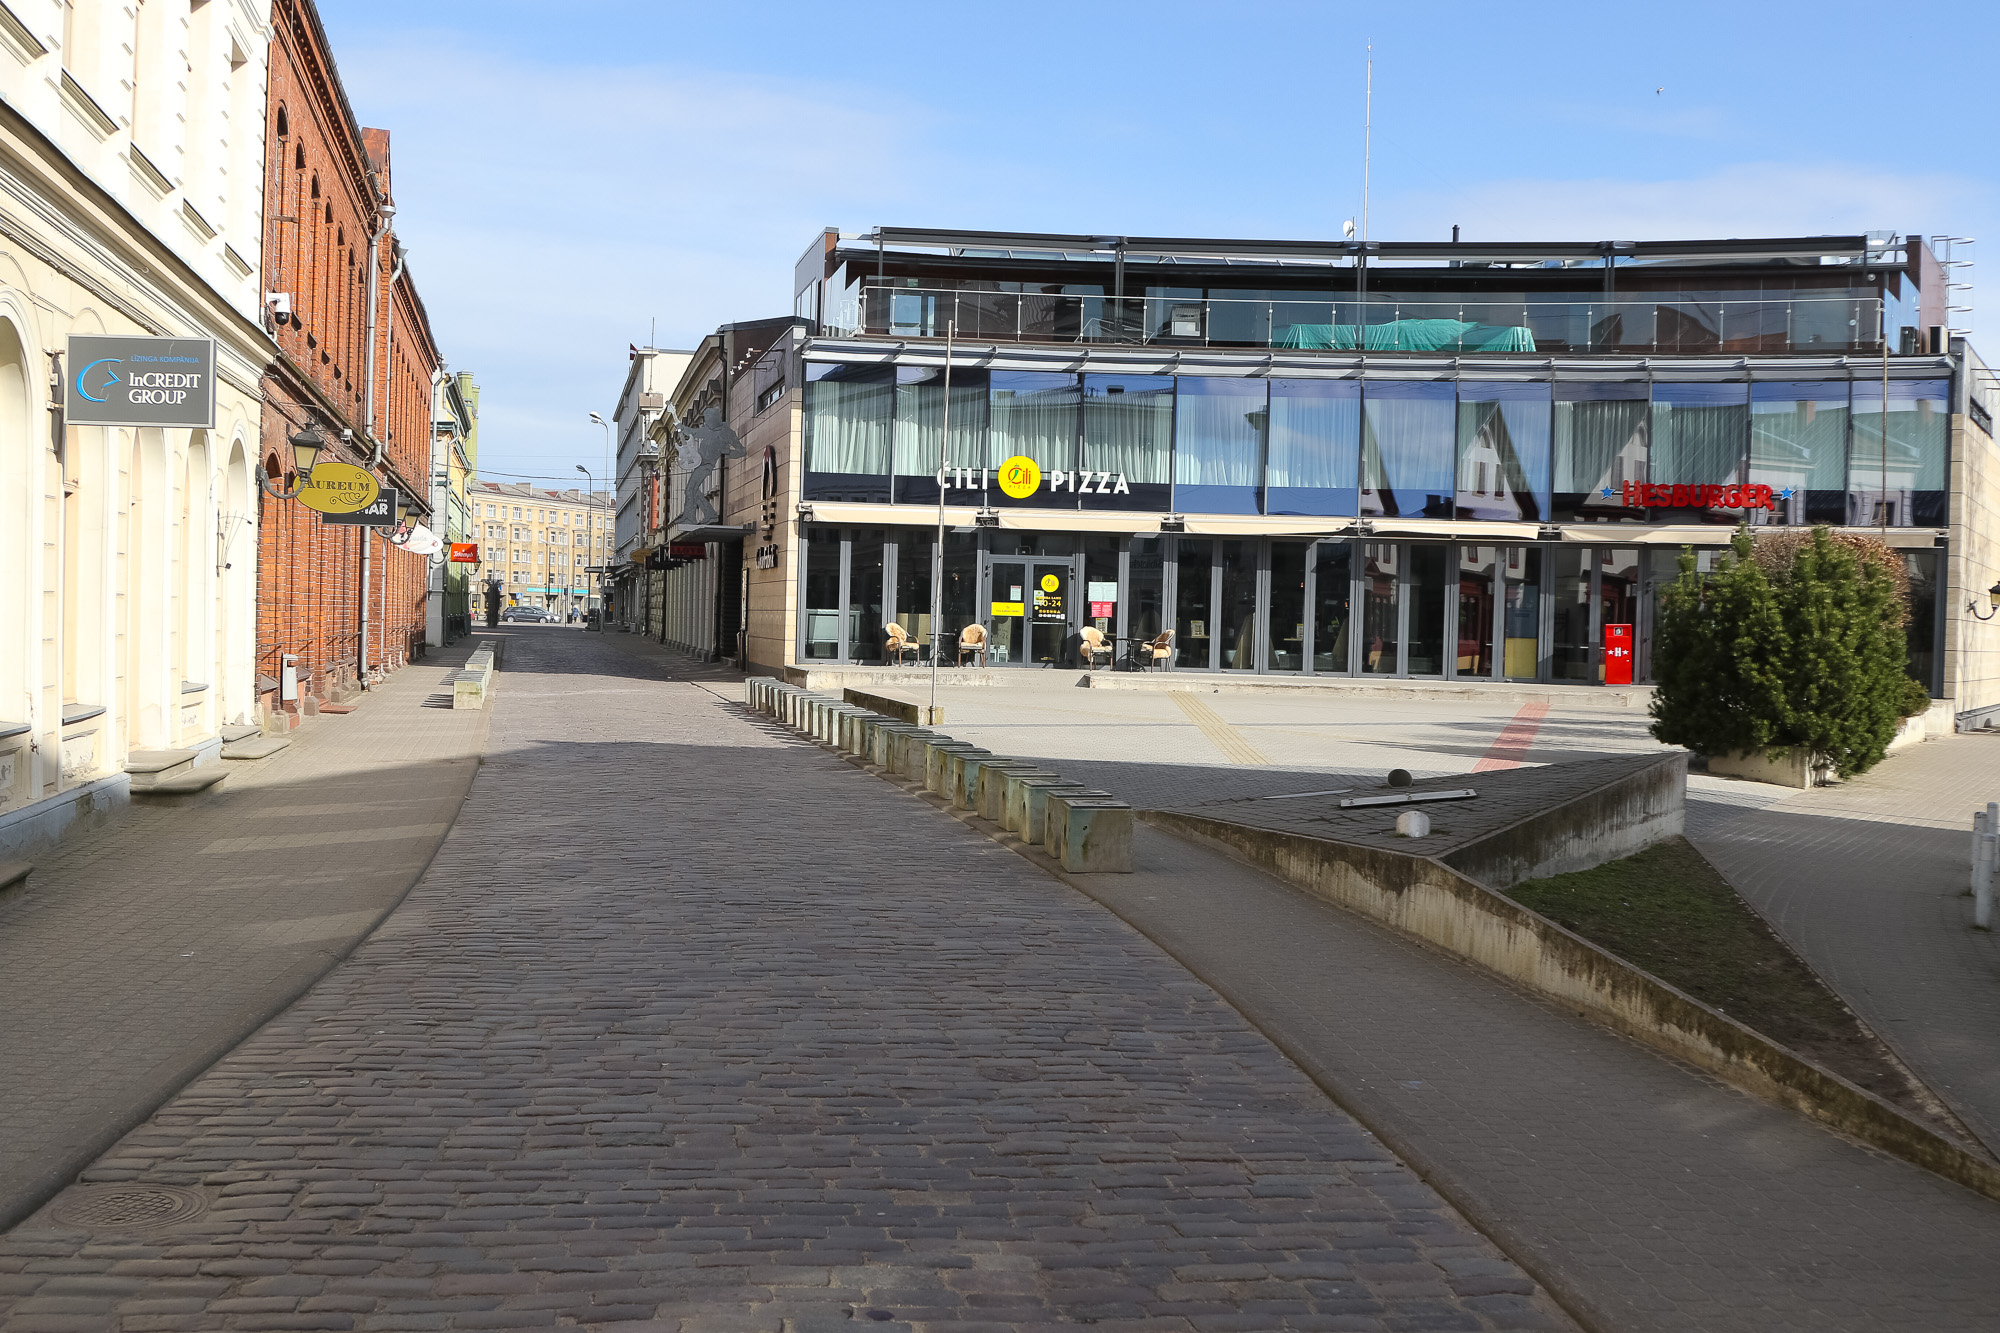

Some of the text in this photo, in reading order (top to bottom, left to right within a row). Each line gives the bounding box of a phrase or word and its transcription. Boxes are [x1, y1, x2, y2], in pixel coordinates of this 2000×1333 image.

[130, 353, 200, 364] LĪZINGA KOMPĀNIJA
[128, 371, 202, 389] InCREDIT
[128, 389, 187, 405] GROUP
[1050, 469, 1130, 495] PIZZA
[1622, 479, 1775, 511] HESBURGER
